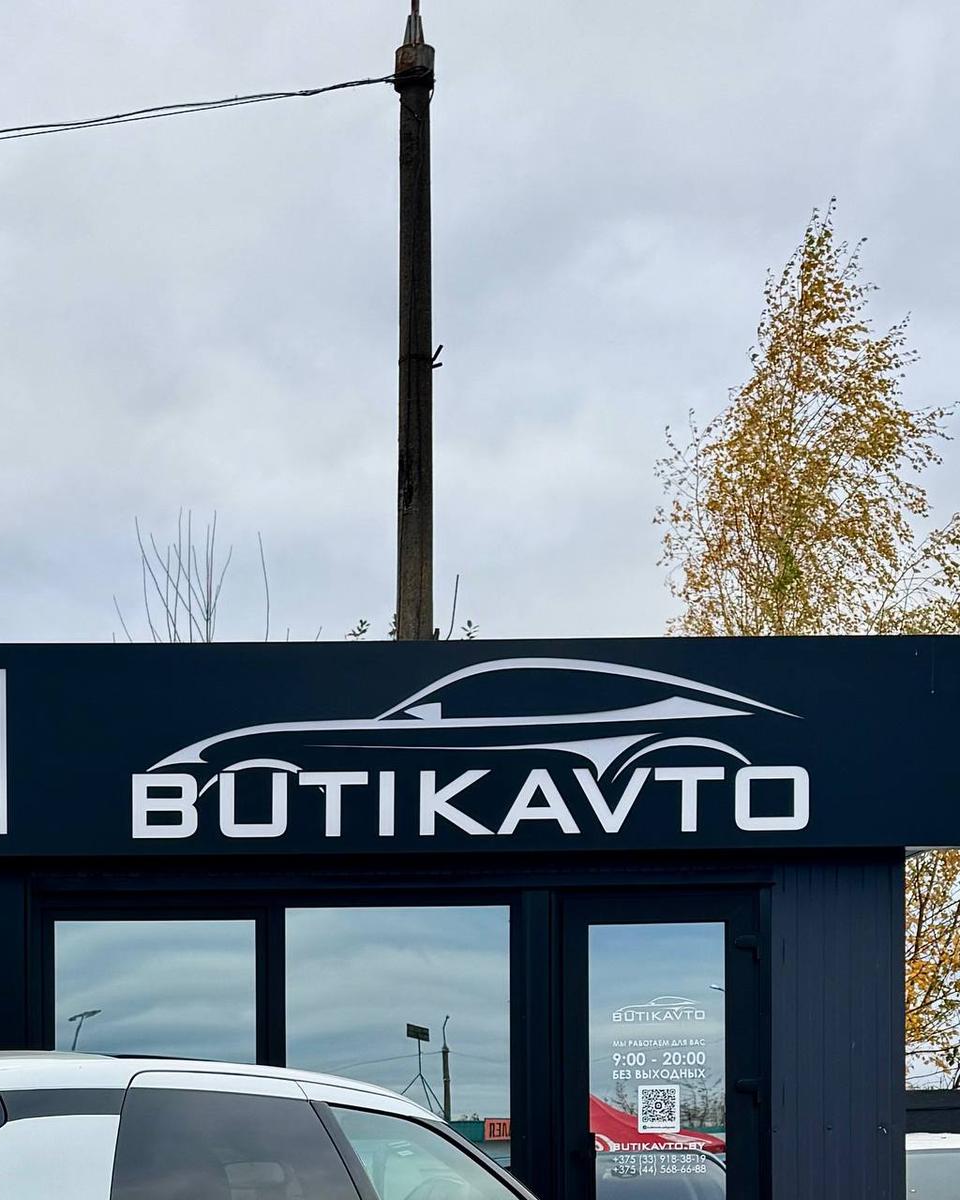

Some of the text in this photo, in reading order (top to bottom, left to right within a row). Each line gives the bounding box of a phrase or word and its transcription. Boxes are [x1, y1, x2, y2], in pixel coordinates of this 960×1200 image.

[131, 764, 811, 839] BUTIKAVTO
[612, 1010, 705, 1022] BUTIKAVTO
[612, 1053, 646, 1066] 9:00
[663, 1052, 706, 1066] 20:00
[613, 1069, 706, 1080] БЕЗ ВЫХОДНЫХ
[612, 1142, 706, 1151] BUTIKAVTO.BY
[613, 1154, 706, 1166] +375 (33) 918-38-19
[613, 1165, 706, 1176] +375 (44) 568-66-88
